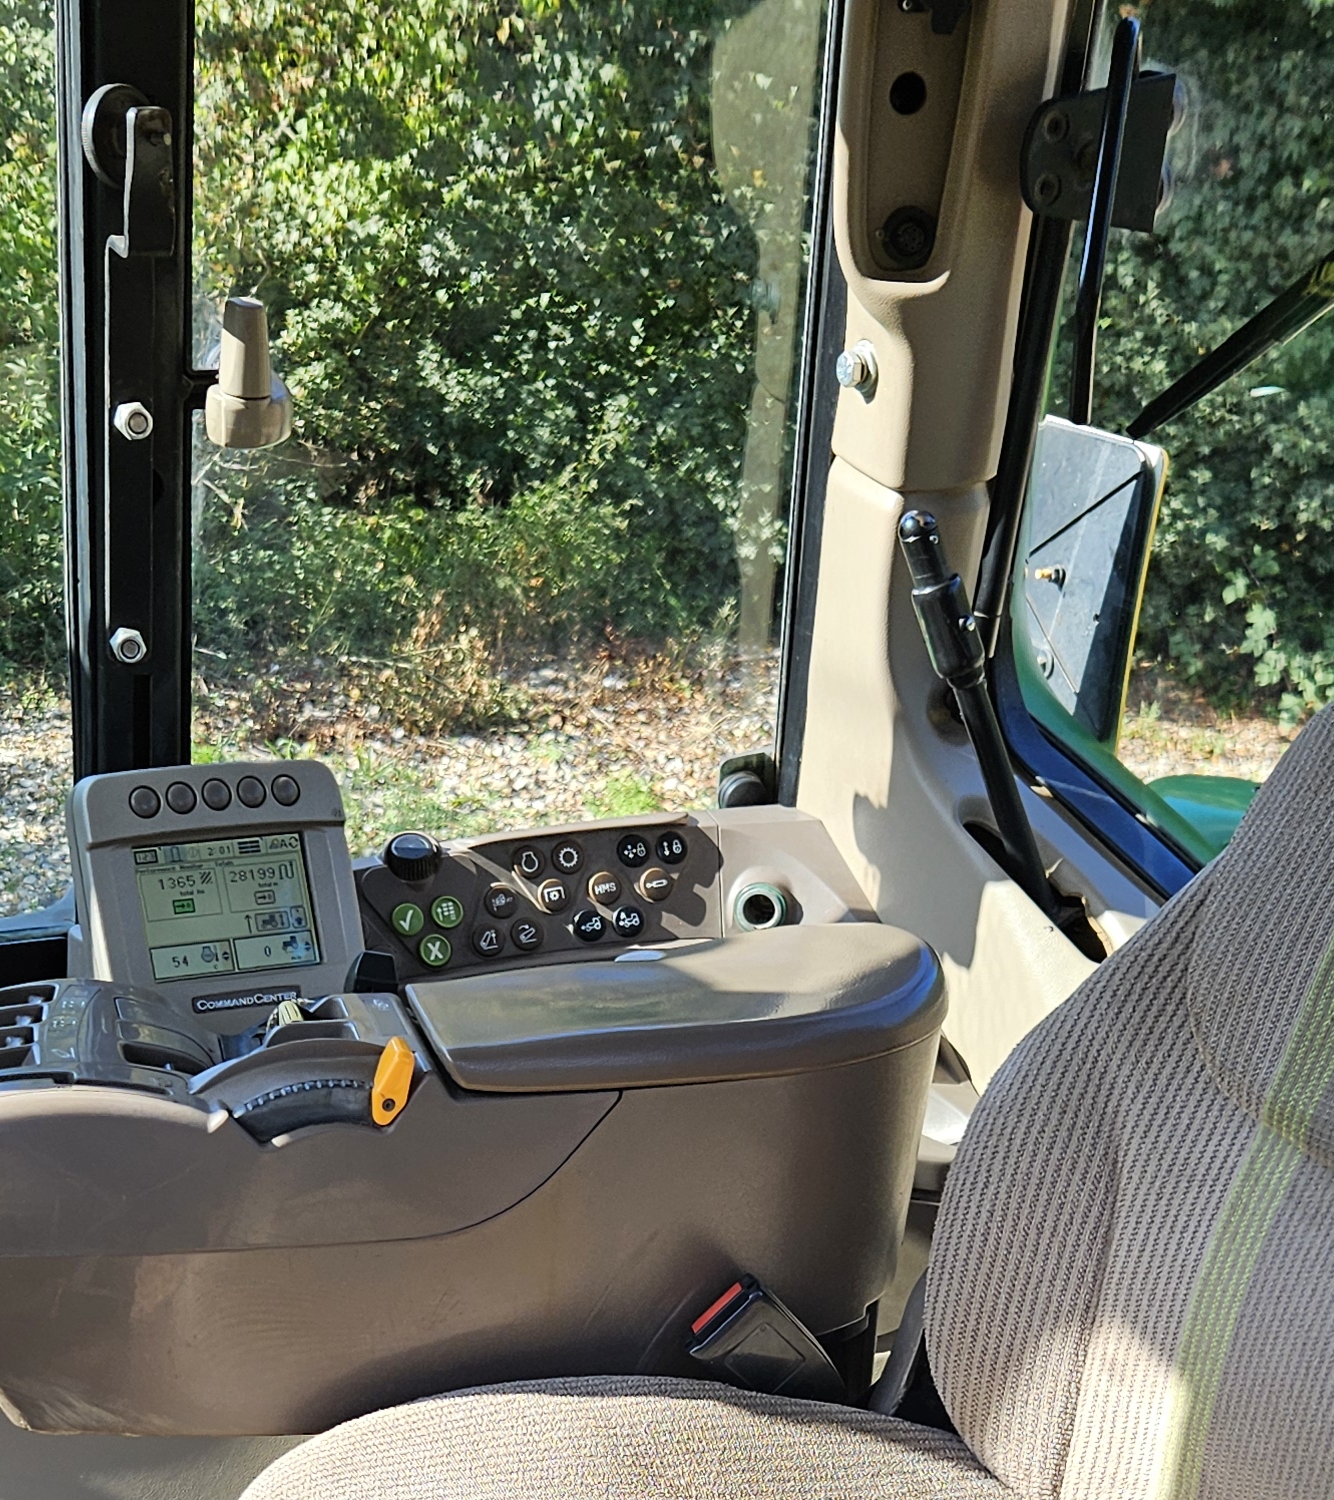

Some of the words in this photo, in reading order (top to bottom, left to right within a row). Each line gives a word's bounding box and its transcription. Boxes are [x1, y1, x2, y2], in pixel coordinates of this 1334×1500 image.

[229, 867, 276, 883] 28199
[158, 875, 196, 890] 1365
[594, 882, 617, 895] HMS
[172, 955, 189, 969] 54
